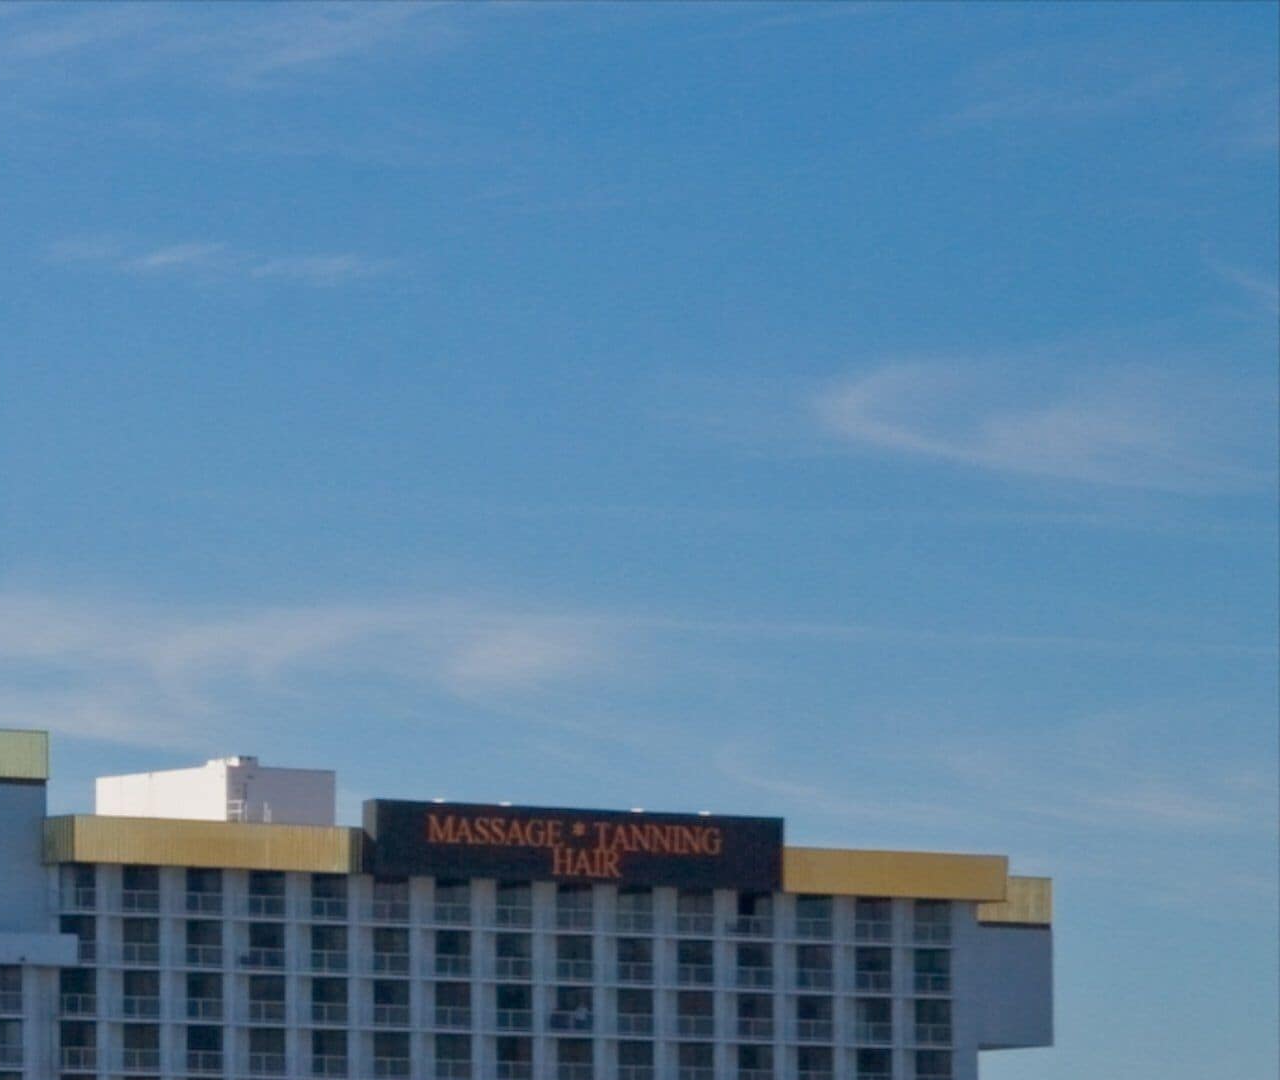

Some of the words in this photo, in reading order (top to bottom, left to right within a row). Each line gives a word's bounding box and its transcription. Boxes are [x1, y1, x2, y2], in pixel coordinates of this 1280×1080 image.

[427, 814, 565, 848] MASSAGE
[594, 822, 722, 855] TANNING
[552, 847, 623, 877] HAIR
